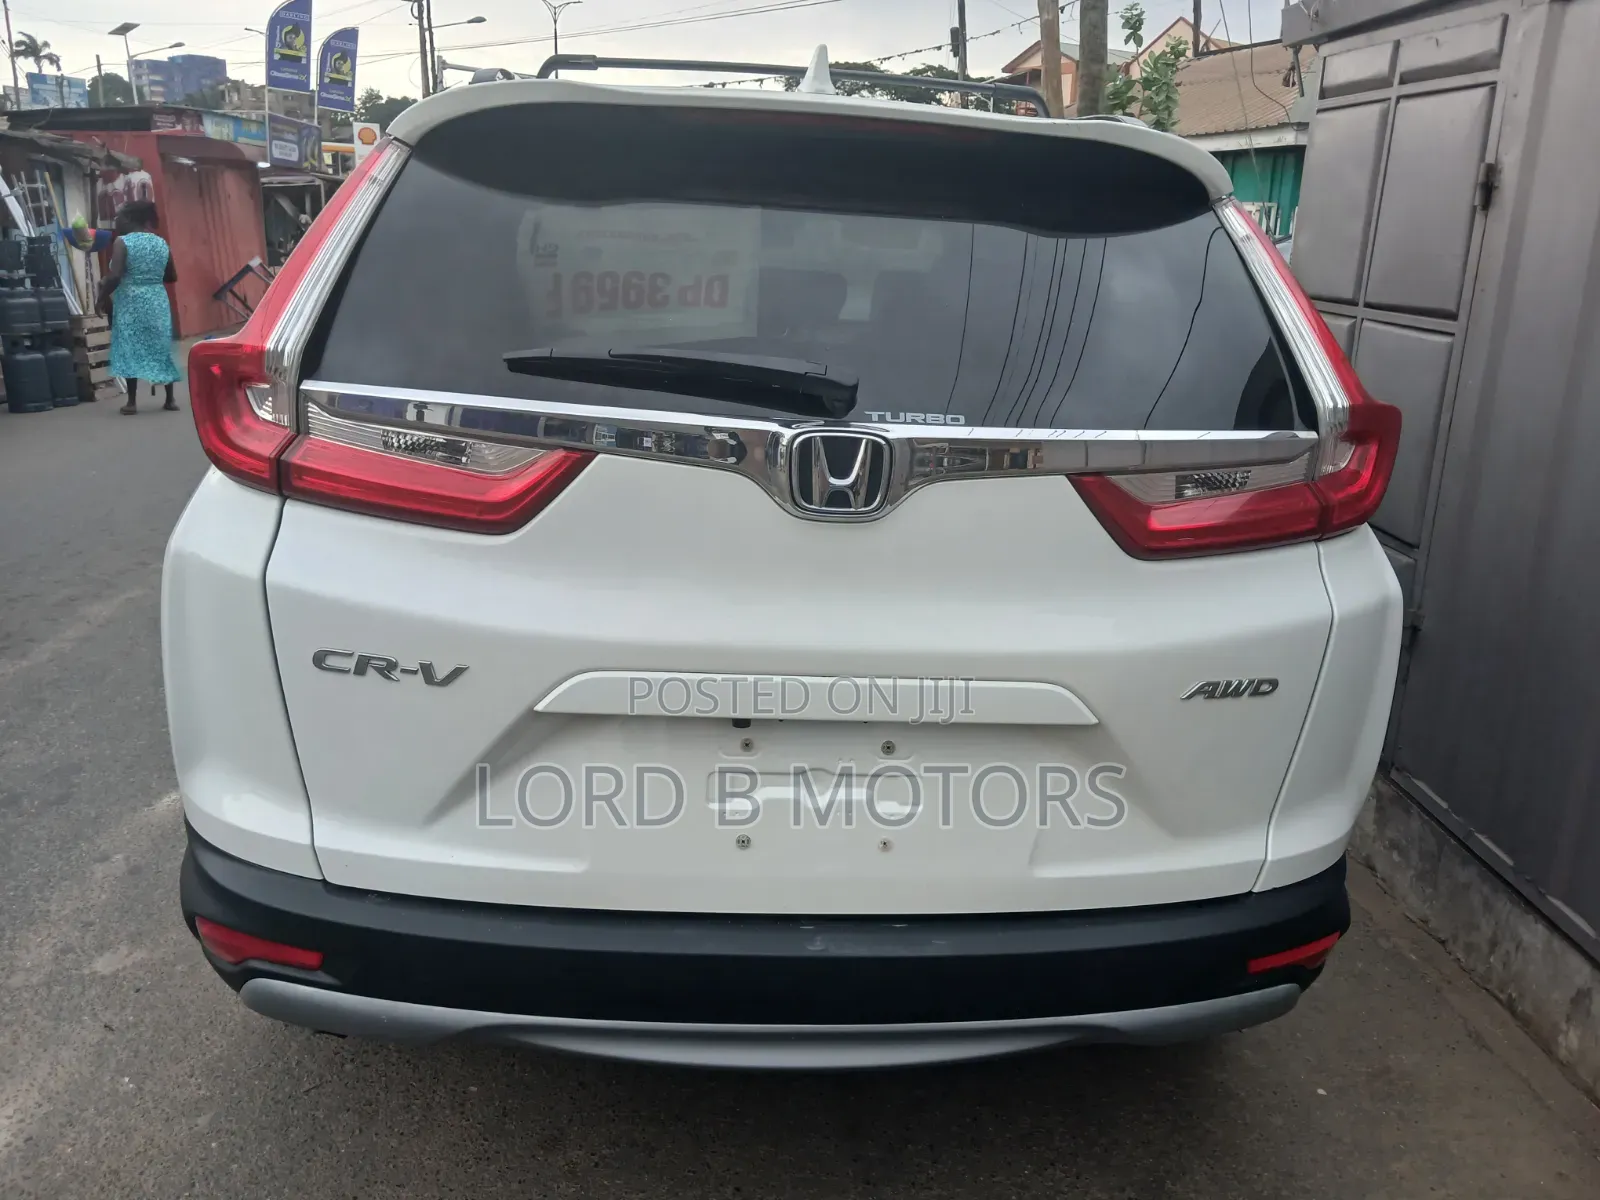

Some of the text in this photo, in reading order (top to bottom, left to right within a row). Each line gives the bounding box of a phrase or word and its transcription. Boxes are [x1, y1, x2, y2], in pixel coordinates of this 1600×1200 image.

[677, 274, 730, 309] DP
[864, 411, 965, 425] TURBO
[312, 647, 470, 687] CR-V
[1180, 677, 1279, 700] AWD
